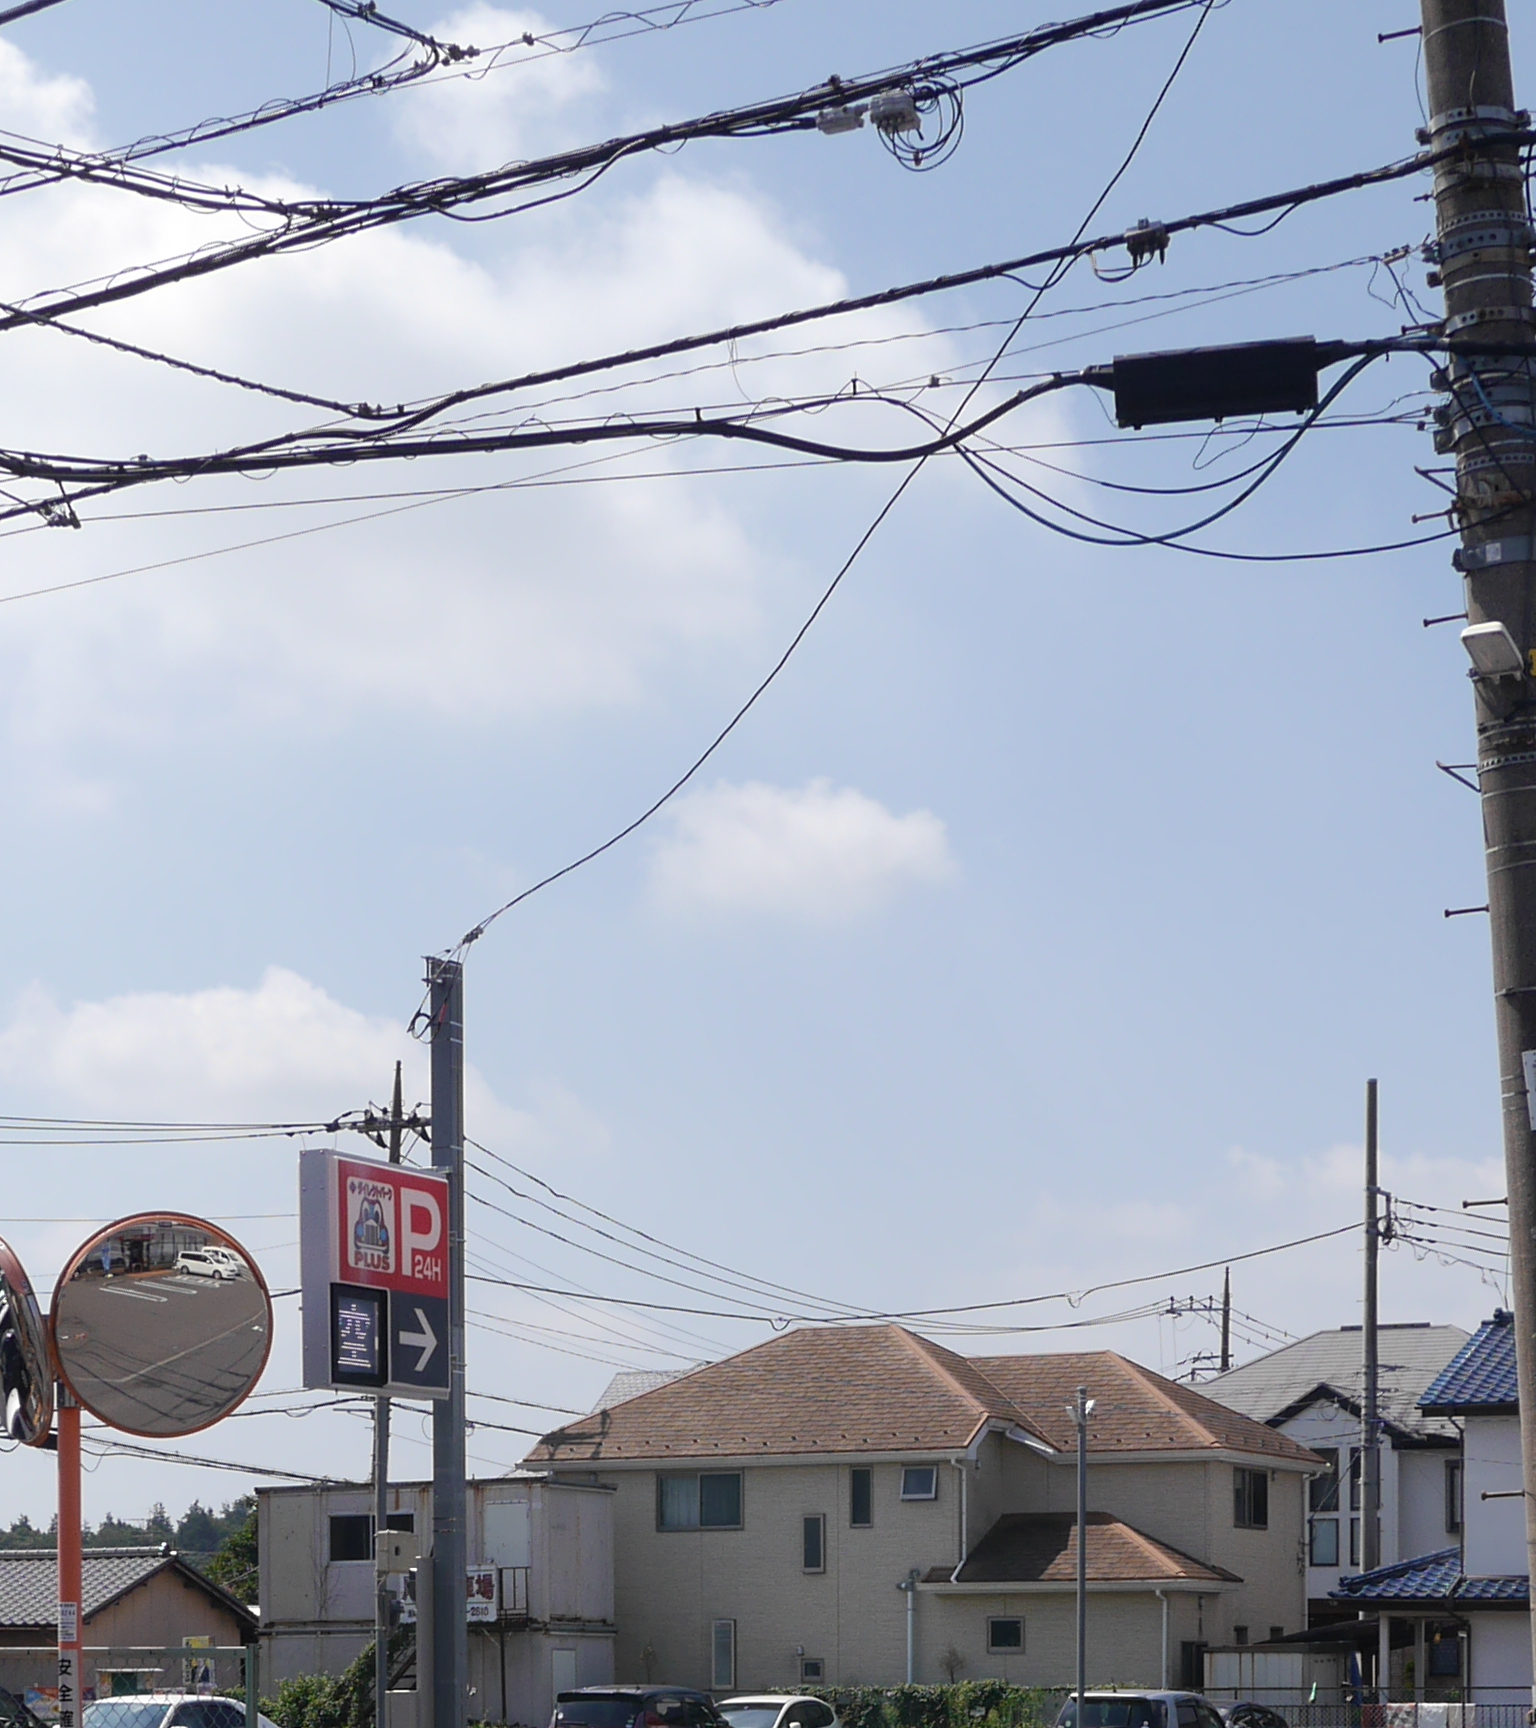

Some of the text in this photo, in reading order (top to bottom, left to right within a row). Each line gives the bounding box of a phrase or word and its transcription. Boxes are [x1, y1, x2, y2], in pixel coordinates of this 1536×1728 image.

[400, 1186, 441, 1277] P
[354, 1251, 390, 1271] PLUS
[415, 1256, 442, 1281] 24H
[337, 1303, 372, 1368] 空
